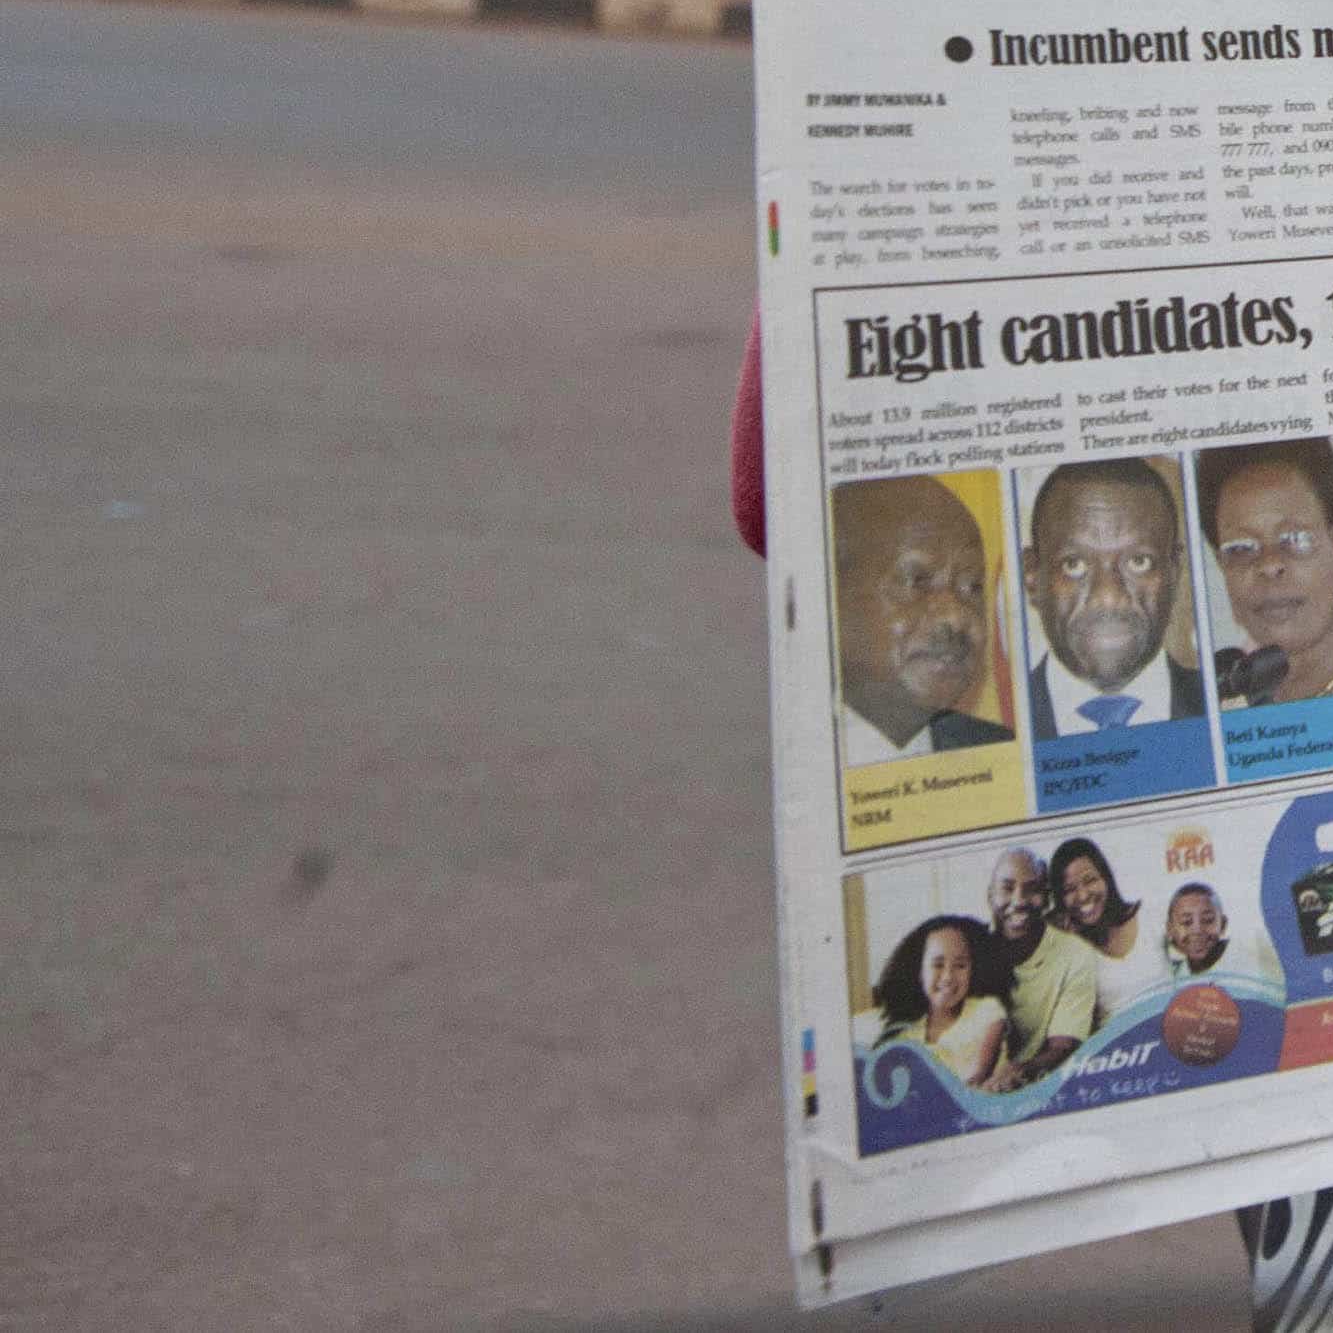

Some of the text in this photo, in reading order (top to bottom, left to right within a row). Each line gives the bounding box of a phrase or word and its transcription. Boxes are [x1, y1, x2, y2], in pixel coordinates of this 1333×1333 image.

[989, 26, 1190, 66] Incumbent
[1202, 24, 1301, 62] sends
[845, 313, 984, 384] Eight
[1001, 292, 1312, 366] candidates,
